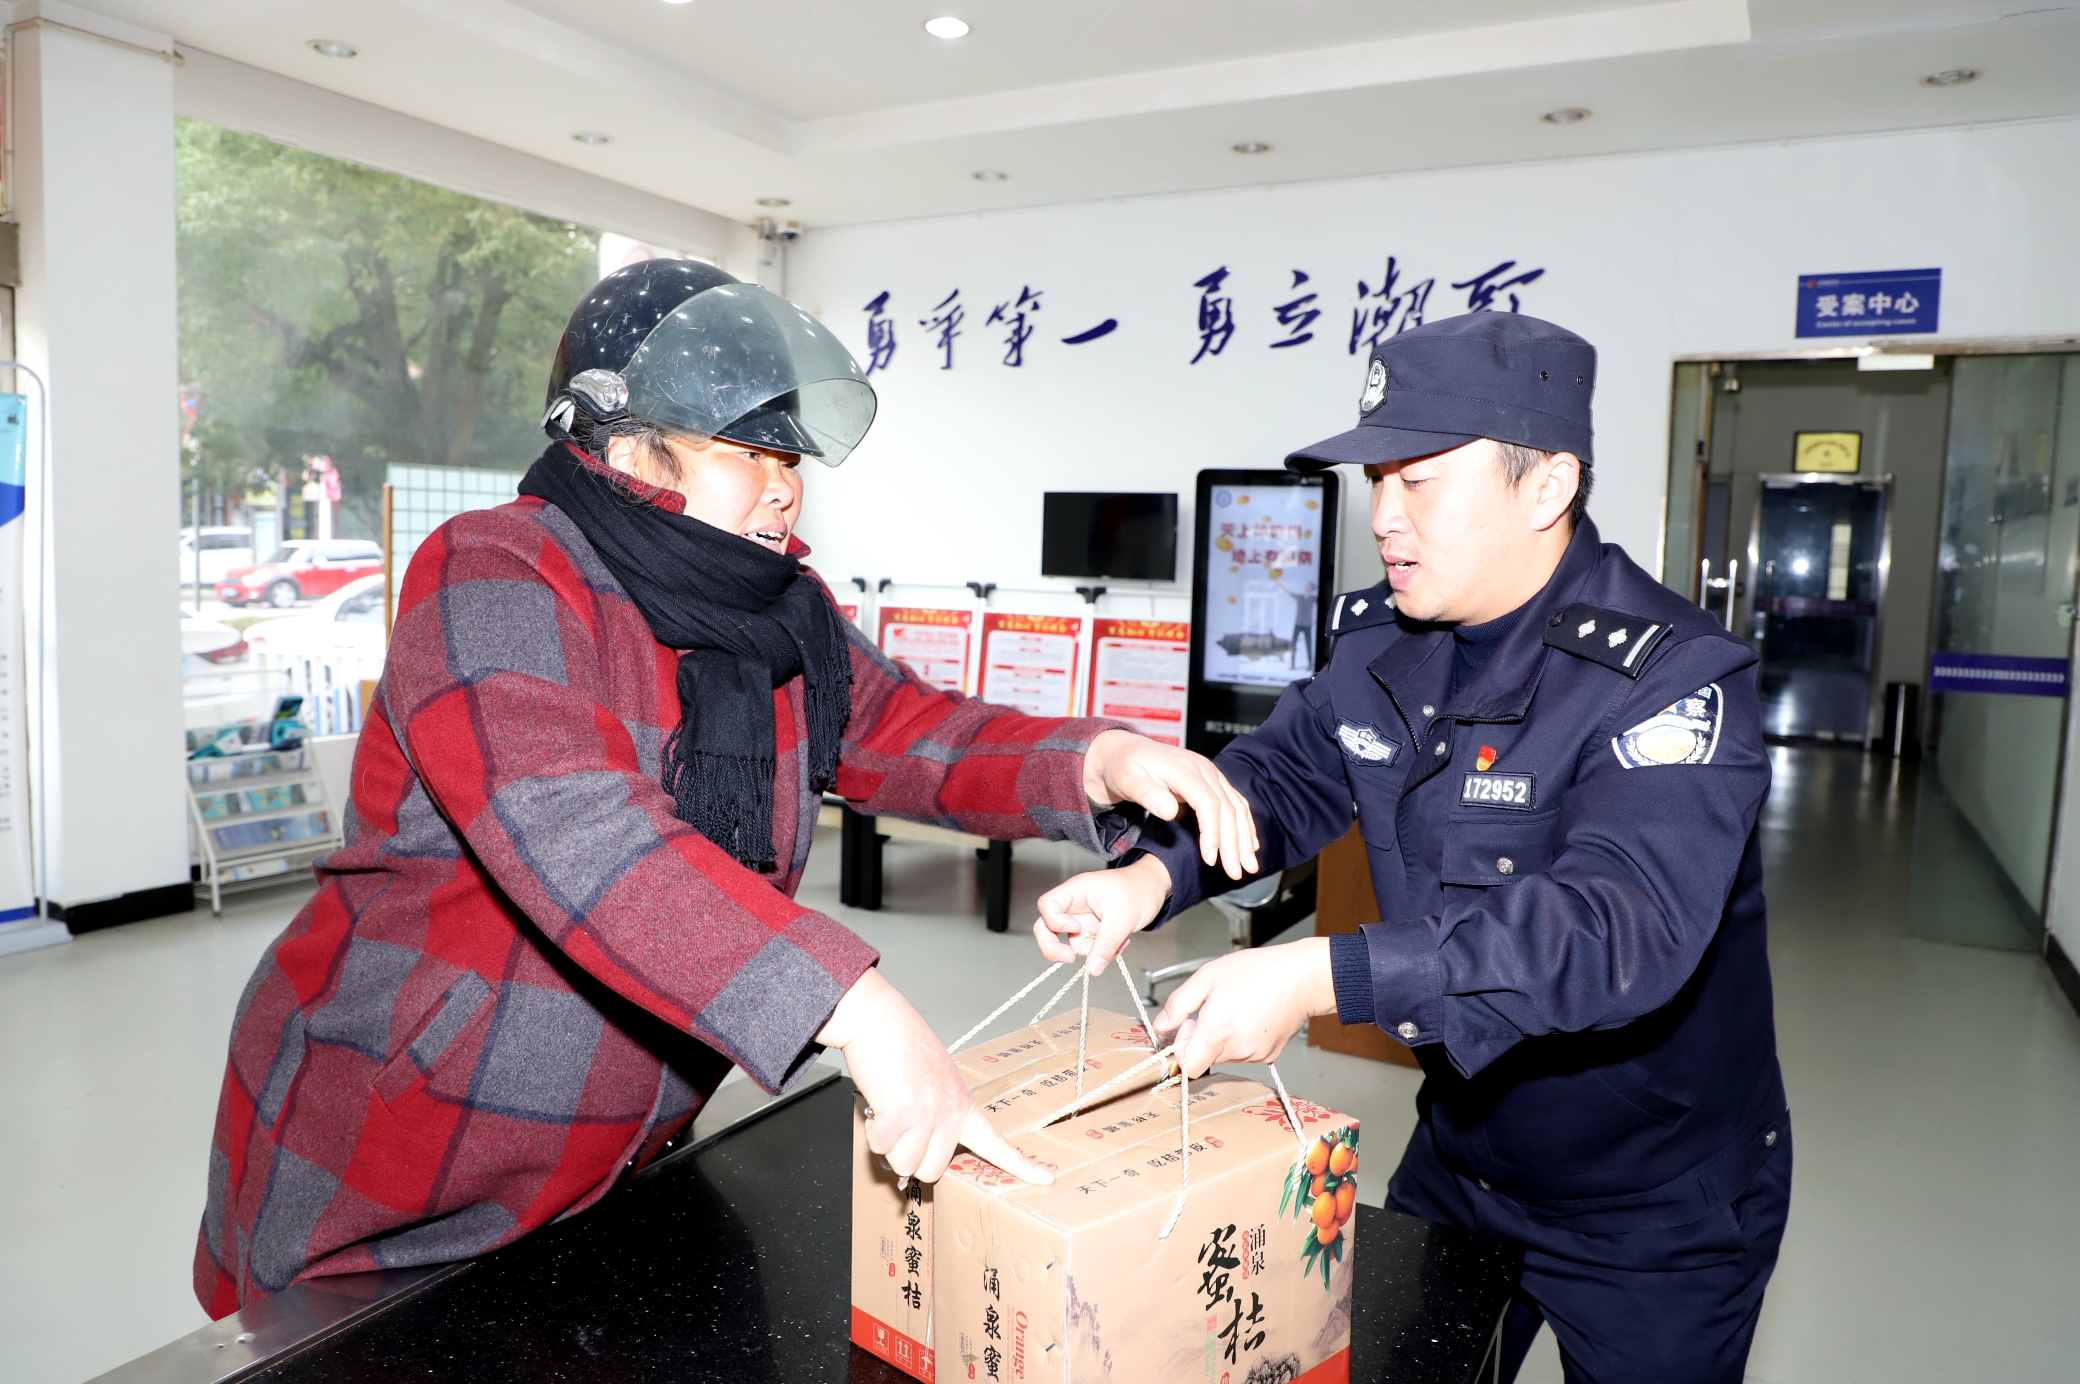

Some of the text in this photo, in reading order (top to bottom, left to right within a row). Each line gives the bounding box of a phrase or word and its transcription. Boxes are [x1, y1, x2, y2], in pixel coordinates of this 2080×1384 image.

[1815, 291, 1920, 318] 受案中心
[1464, 777, 1527, 804] 172952
[984, 1088, 1037, 1113] 天下一奇
[1076, 1168, 1140, 1195] 天下一奇
[901, 1177, 923, 1310] 涌泉蜜桔
[1249, 1223, 1266, 1277] 涌泉
[1197, 1223, 1266, 1365] 蜜桔
[982, 1267, 1002, 1383] 涌泉蜜
[1012, 1310, 1029, 1380] Orange
